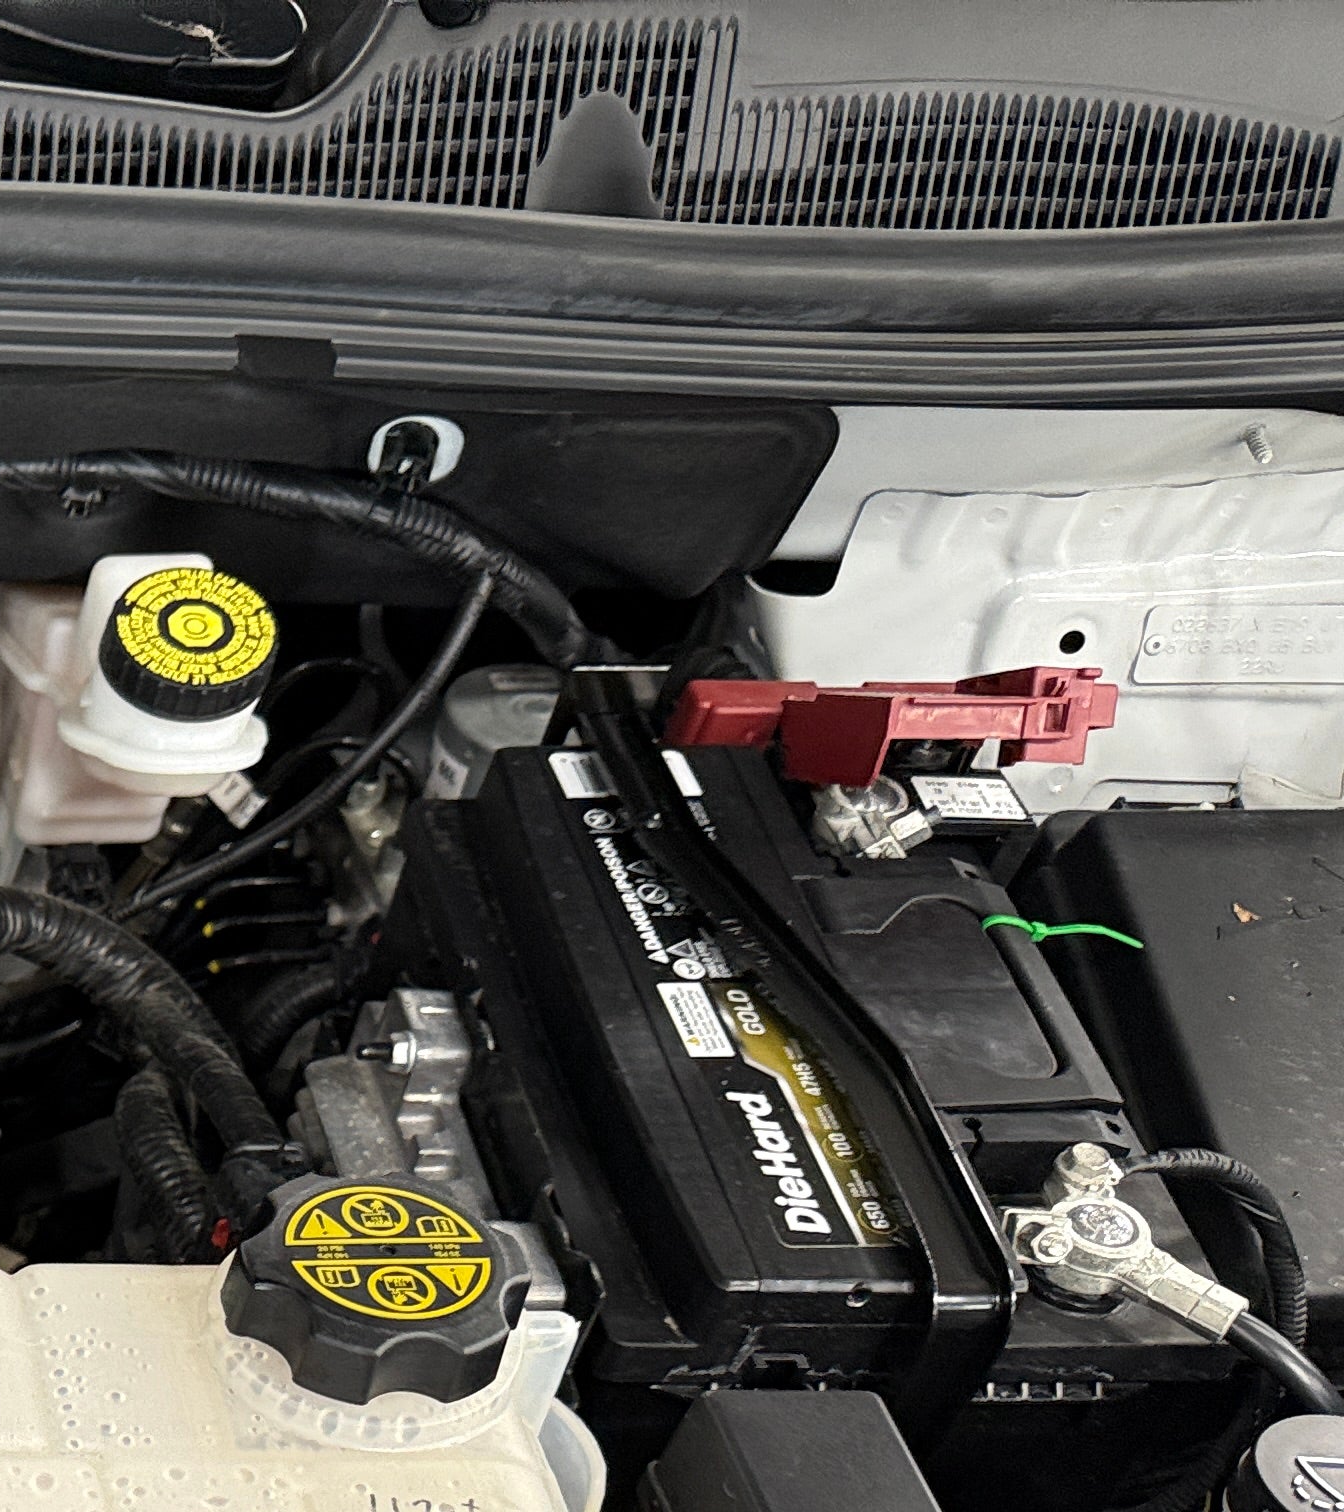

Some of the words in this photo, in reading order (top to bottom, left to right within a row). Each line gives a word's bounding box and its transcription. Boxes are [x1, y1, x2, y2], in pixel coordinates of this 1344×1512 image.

[726, 989, 766, 1036] GOLD
[725, 1091, 832, 1235] DieHard
[828, 1132, 854, 1157] 100
[862, 1201, 890, 1229] 650
